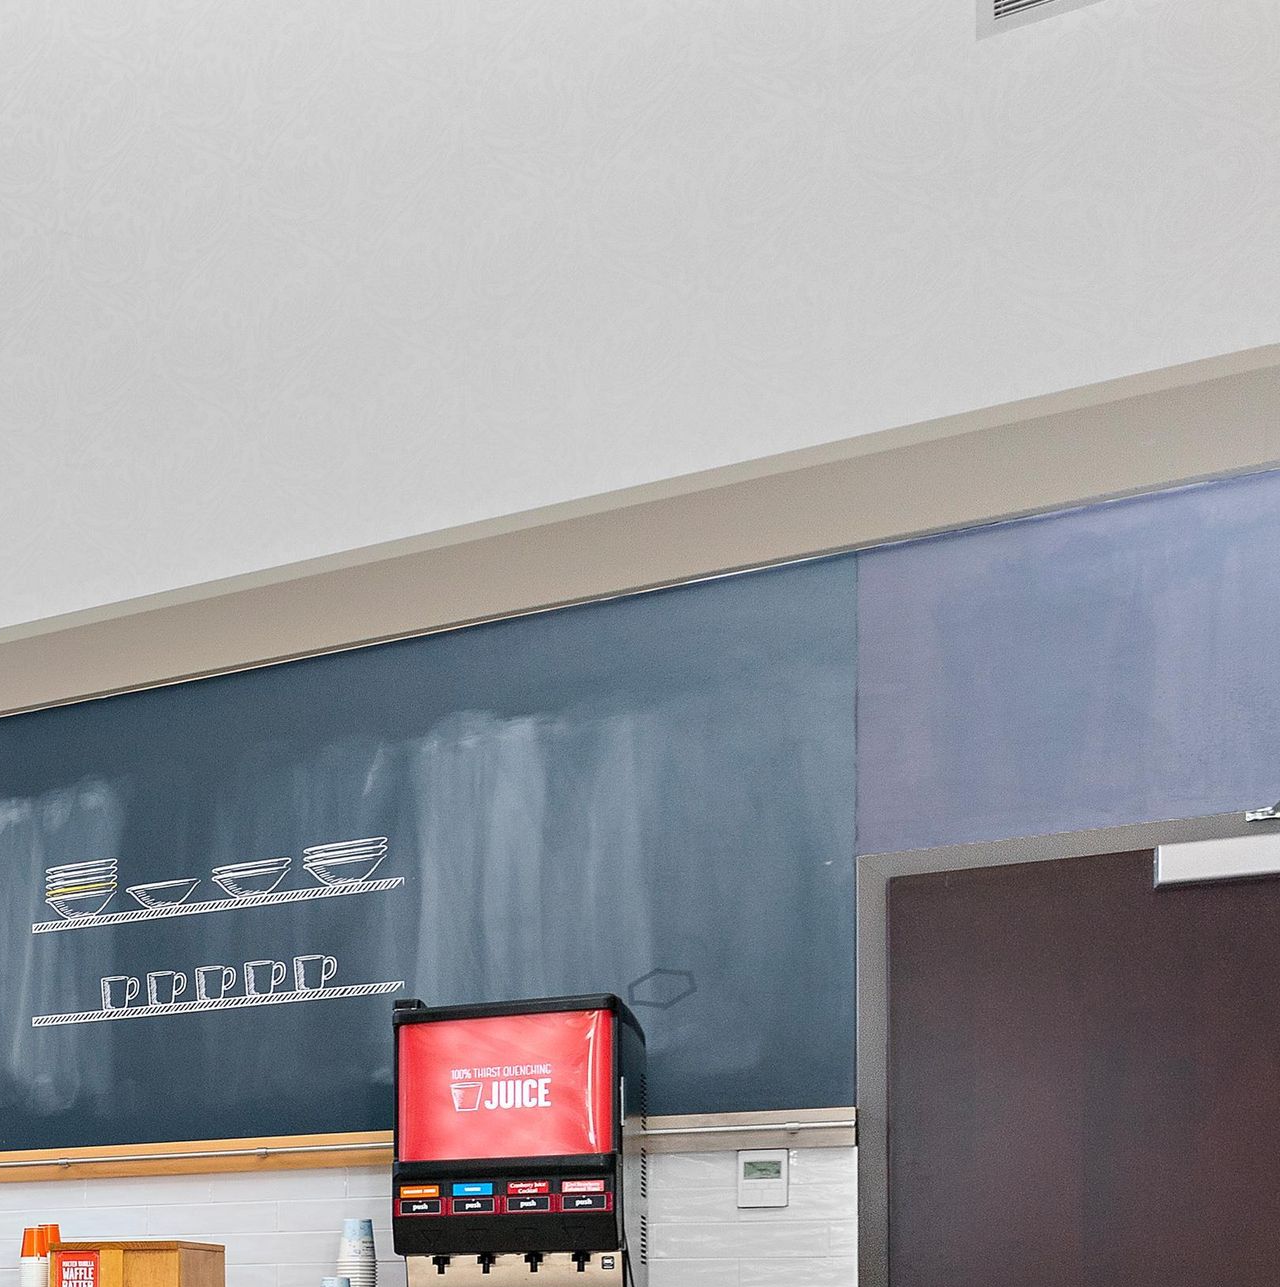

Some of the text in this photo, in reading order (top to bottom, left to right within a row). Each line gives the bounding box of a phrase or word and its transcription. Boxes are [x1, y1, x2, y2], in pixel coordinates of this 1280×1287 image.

[451, 1063, 552, 1080] 100% THIRST QUENCHING
[484, 1077, 552, 1110] JUICE
[412, 1203, 429, 1212] push
[465, 1201, 482, 1210] push
[520, 1199, 537, 1209] push
[575, 1198, 593, 1207] push
[62, 1267, 94, 1280] WAFFLE
